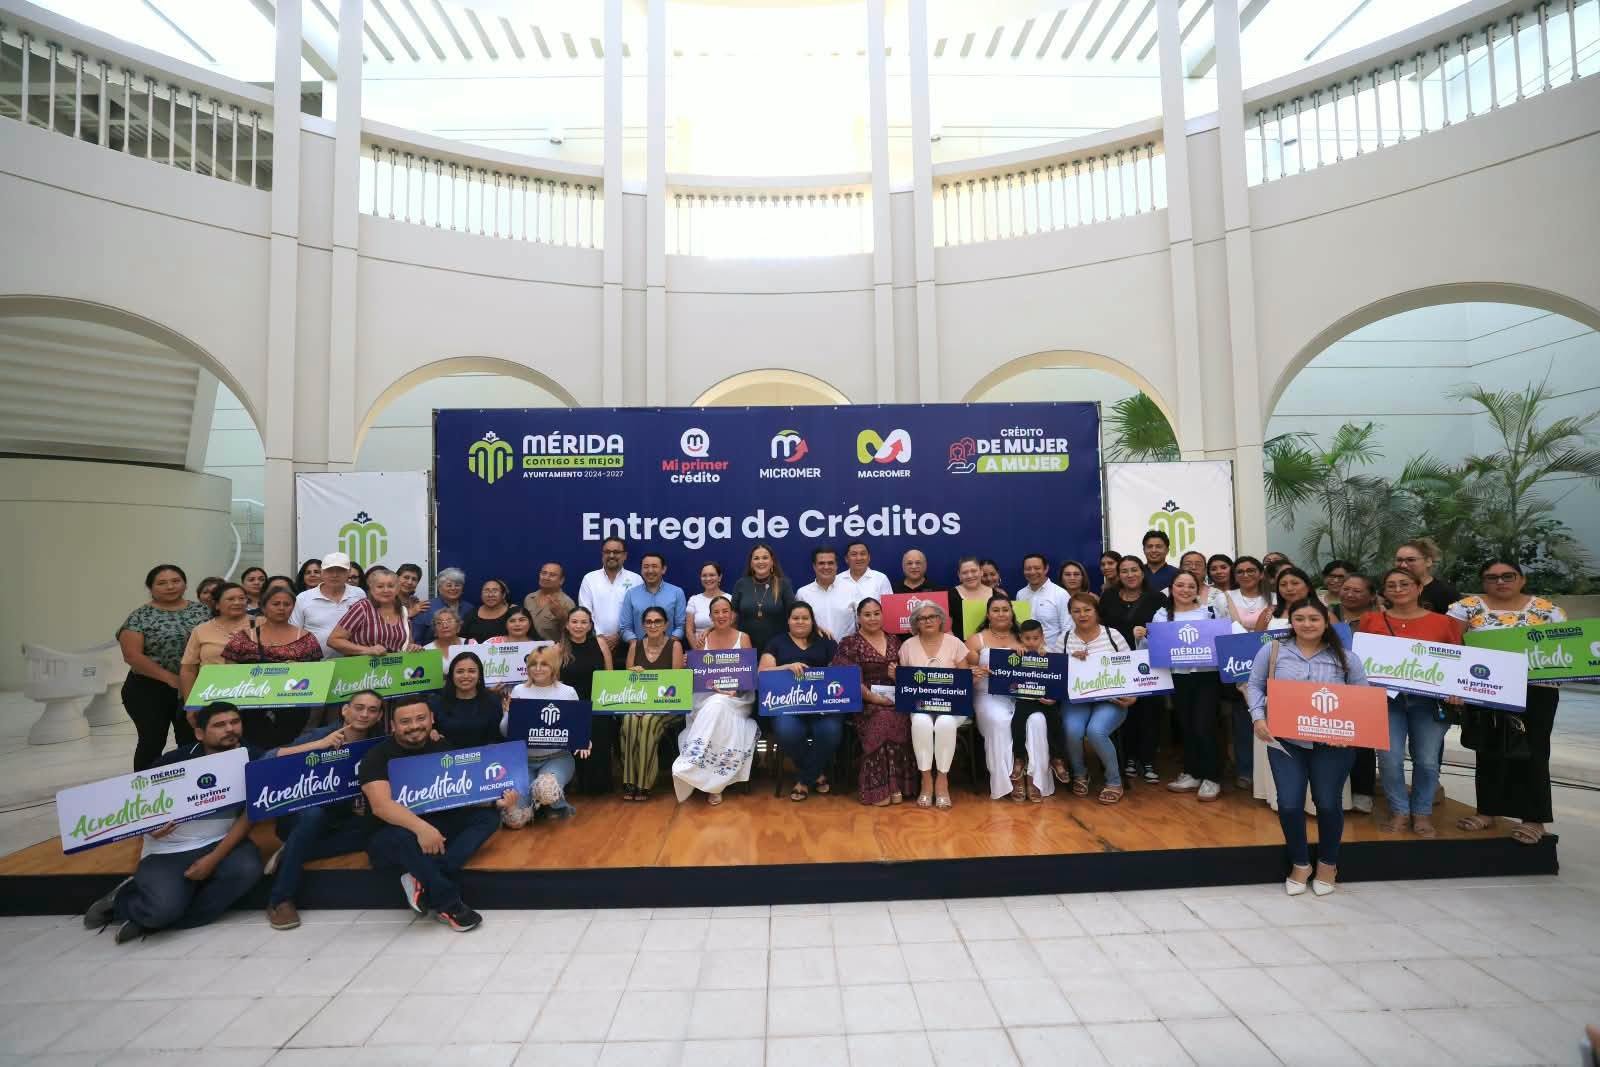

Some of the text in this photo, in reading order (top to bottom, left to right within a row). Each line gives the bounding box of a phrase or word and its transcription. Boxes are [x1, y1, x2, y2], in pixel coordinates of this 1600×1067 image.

[1000, 426, 1044, 437] CRÉDITO
[523, 431, 624, 454] MÉRIDA
[977, 438, 1068, 454] DE MUJER
[526, 456, 622, 467] CONTIGO ES MEJOR
[662, 460, 729, 474] Mi primer
[985, 457, 1062, 472] A MUJER
[584, 470, 624, 478] 2024-2027
[670, 471, 720, 483] crédito
[760, 468, 821, 478] MICROMER
[858, 470, 911, 478] MACROMER
[582, 504, 961, 550] Entrega de Créditos
[1171, 646, 1212, 656] MÉRIDA
[1012, 670, 1062, 680] beneficiaria!
[1362, 657, 1445, 685] Acreditado
[333, 671, 394, 695] Acreditado
[1072, 669, 1126, 692] Acreditado
[1458, 678, 1504, 690] Mi primer
[199, 680, 272, 700] Acreditado
[762, 684, 818, 708] Acreditado
[918, 686, 967, 695] beneficiaria!
[1298, 715, 1354, 730] MÉRIDA
[528, 726, 569, 736] MÉRIDA
[253, 767, 340, 808] Acreditado
[396, 770, 473, 807] Acreditado
[480, 780, 514, 792] MICROMER
[194, 794, 226, 806] crédito
[200, 786, 231, 801] primer
[70, 789, 174, 838] Acreditado
